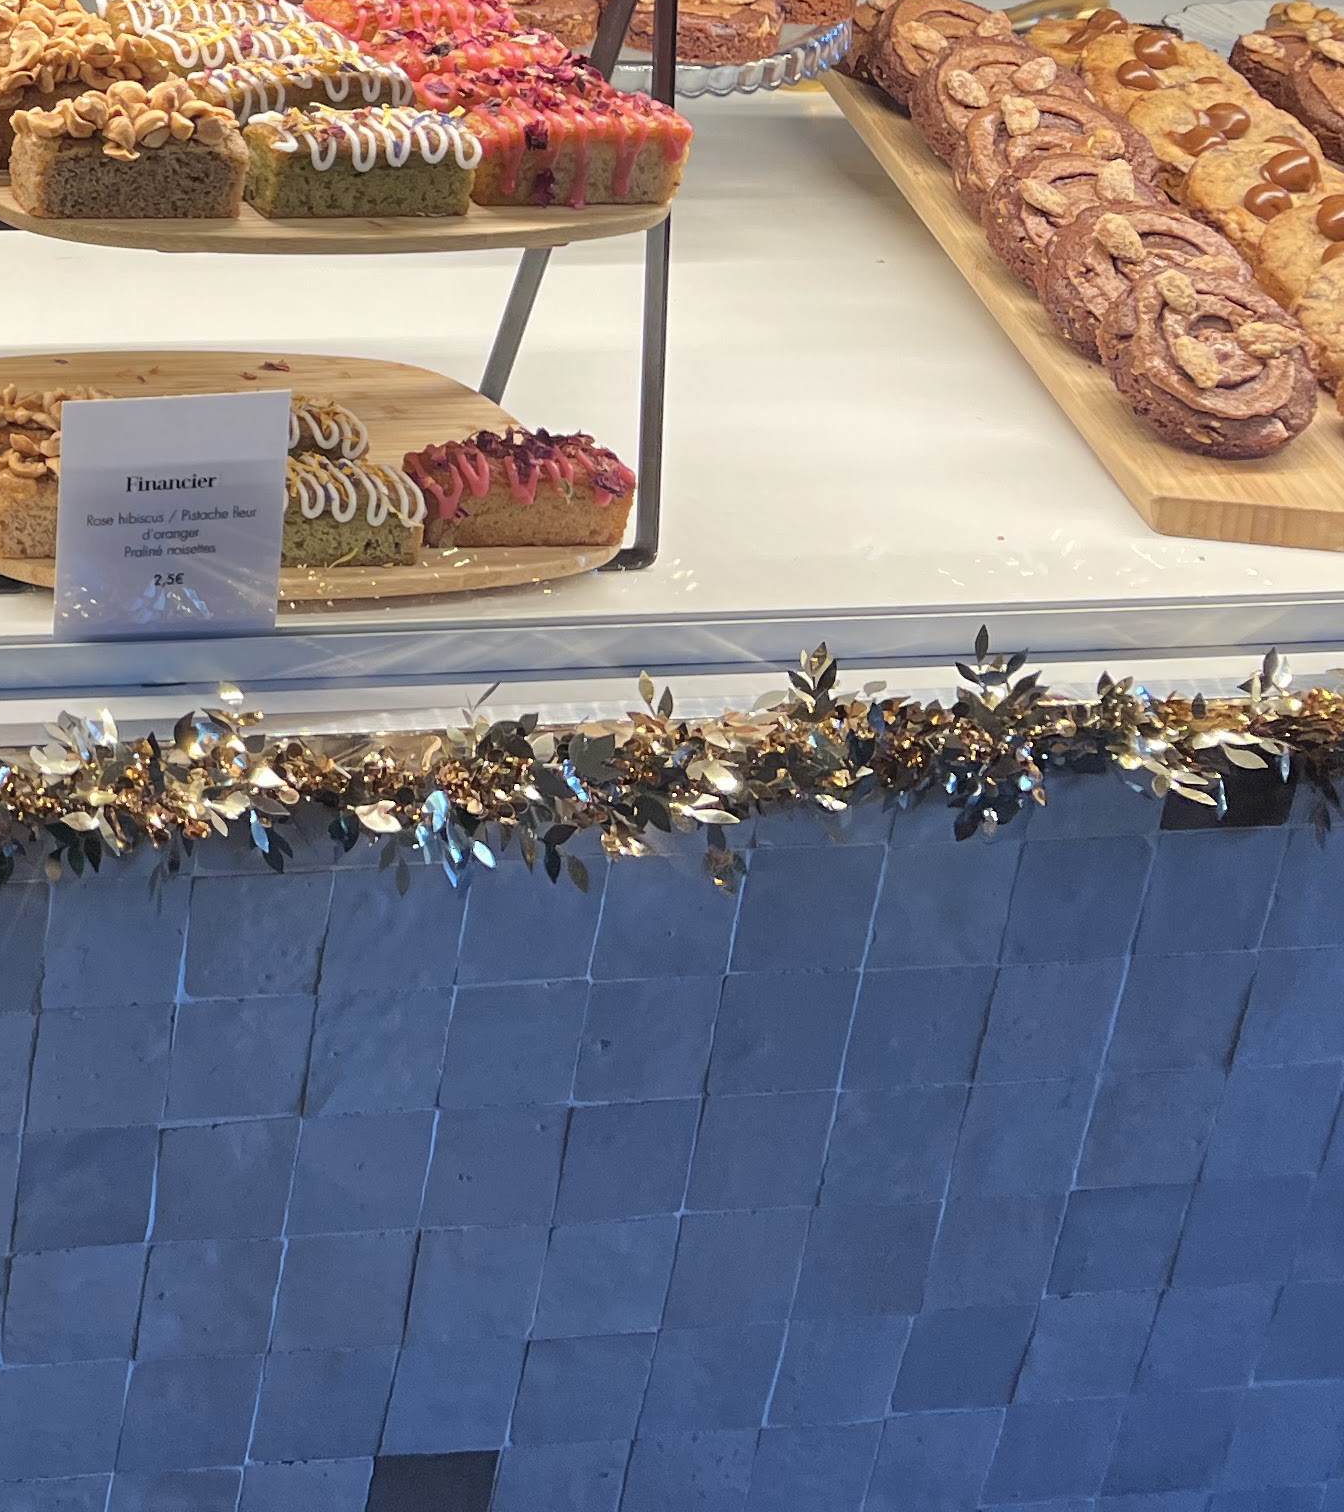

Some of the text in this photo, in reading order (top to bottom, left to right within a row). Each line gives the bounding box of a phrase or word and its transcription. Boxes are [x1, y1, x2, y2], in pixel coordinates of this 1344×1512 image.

[126, 474, 217, 493] Financier
[87, 514, 114, 526] Rose
[118, 511, 164, 524] hibiscus
[181, 508, 228, 522] Pistache
[124, 544, 216, 558] Praliné noisettes
